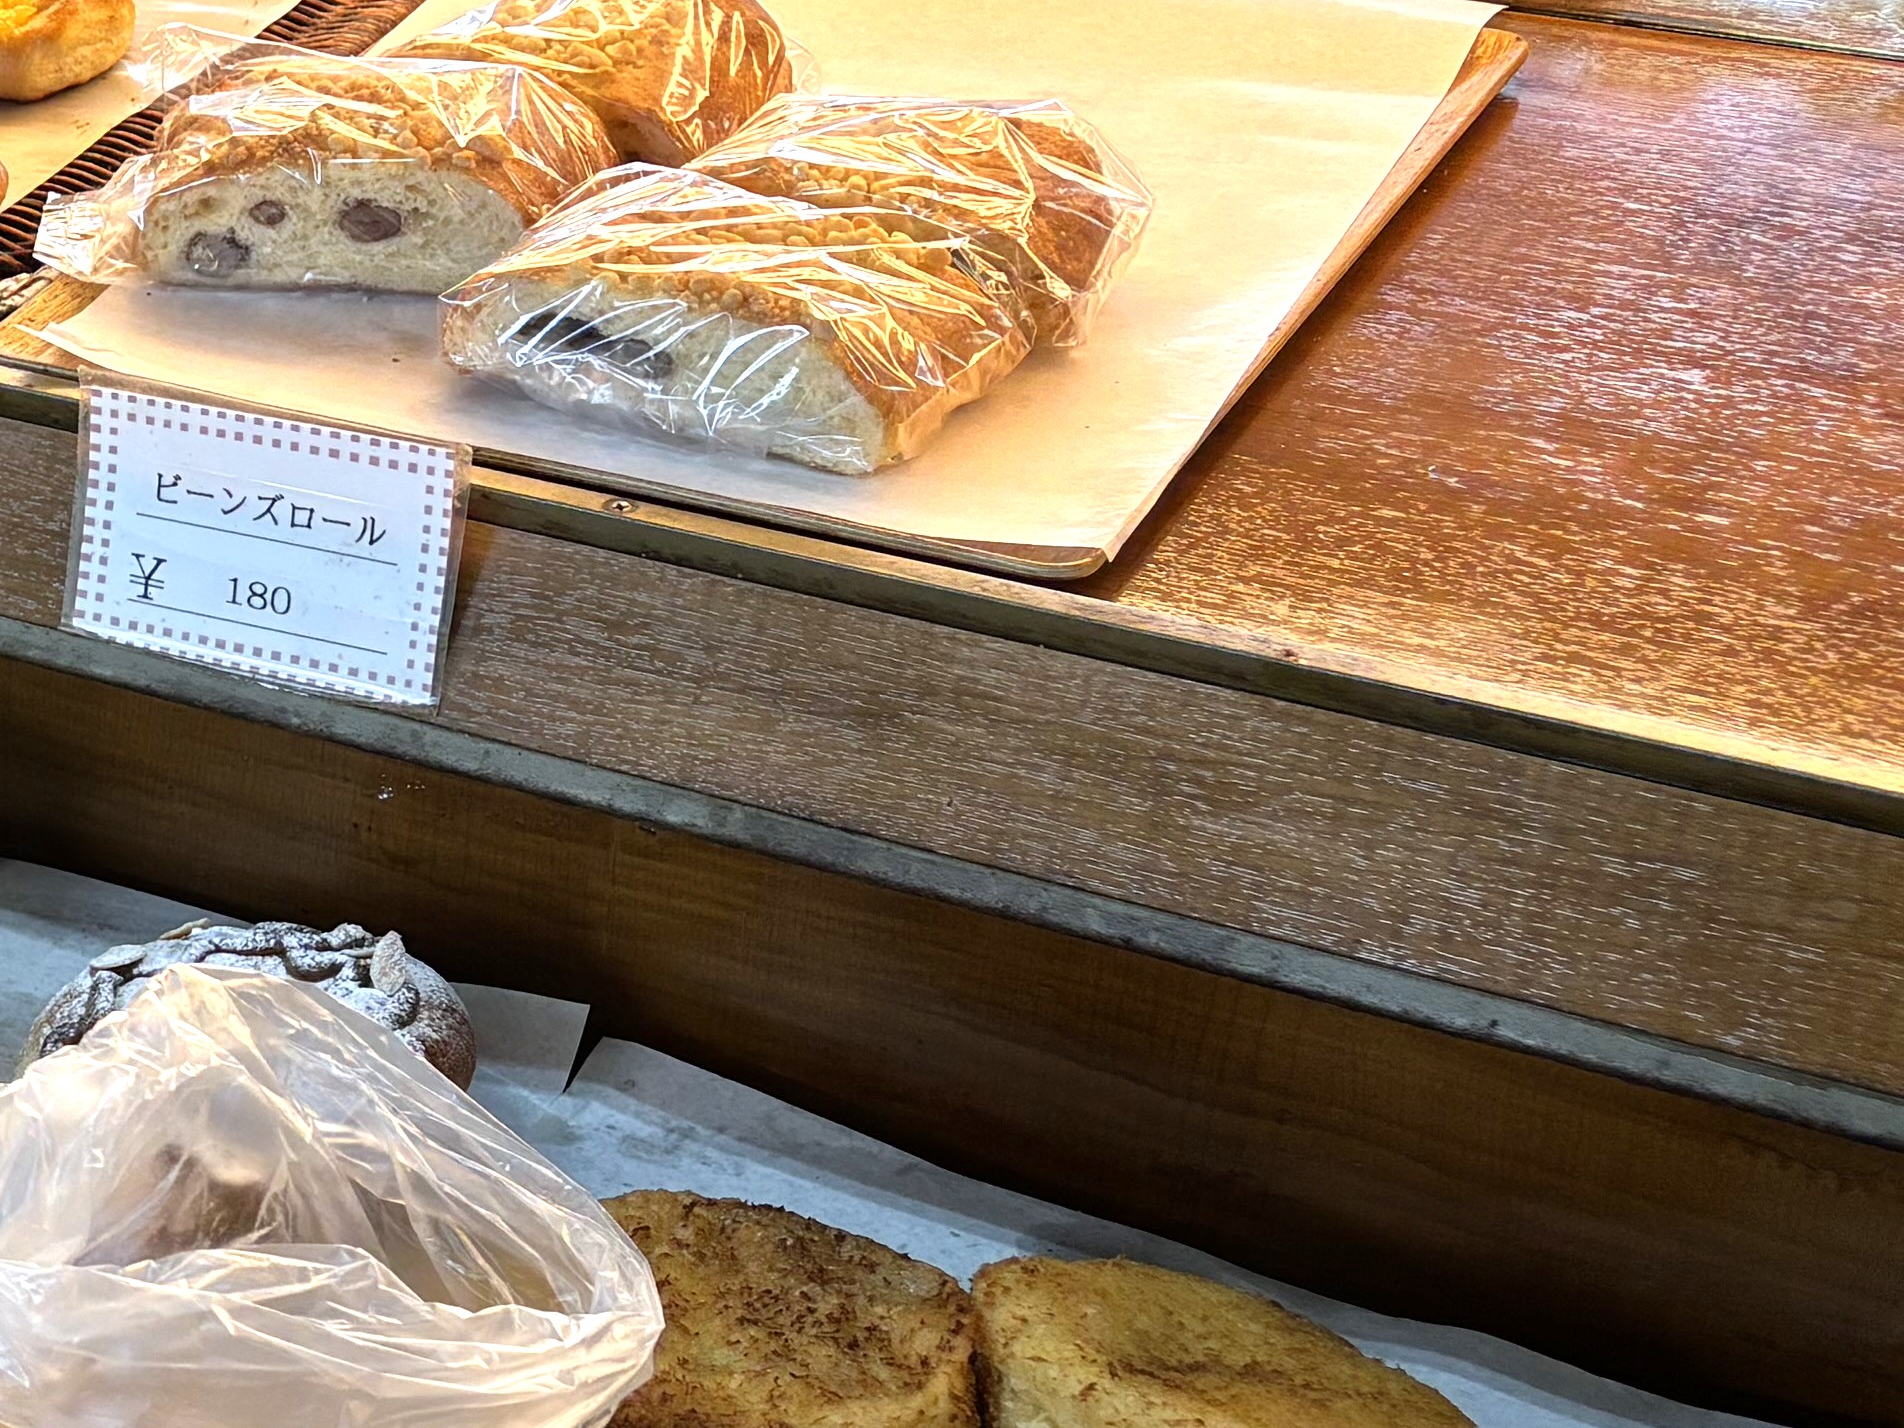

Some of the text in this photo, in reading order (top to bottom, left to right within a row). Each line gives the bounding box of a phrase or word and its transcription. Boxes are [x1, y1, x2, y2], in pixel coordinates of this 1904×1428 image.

[155, 472, 386, 547] ビーンズロール
[225, 577, 292, 616] 180
